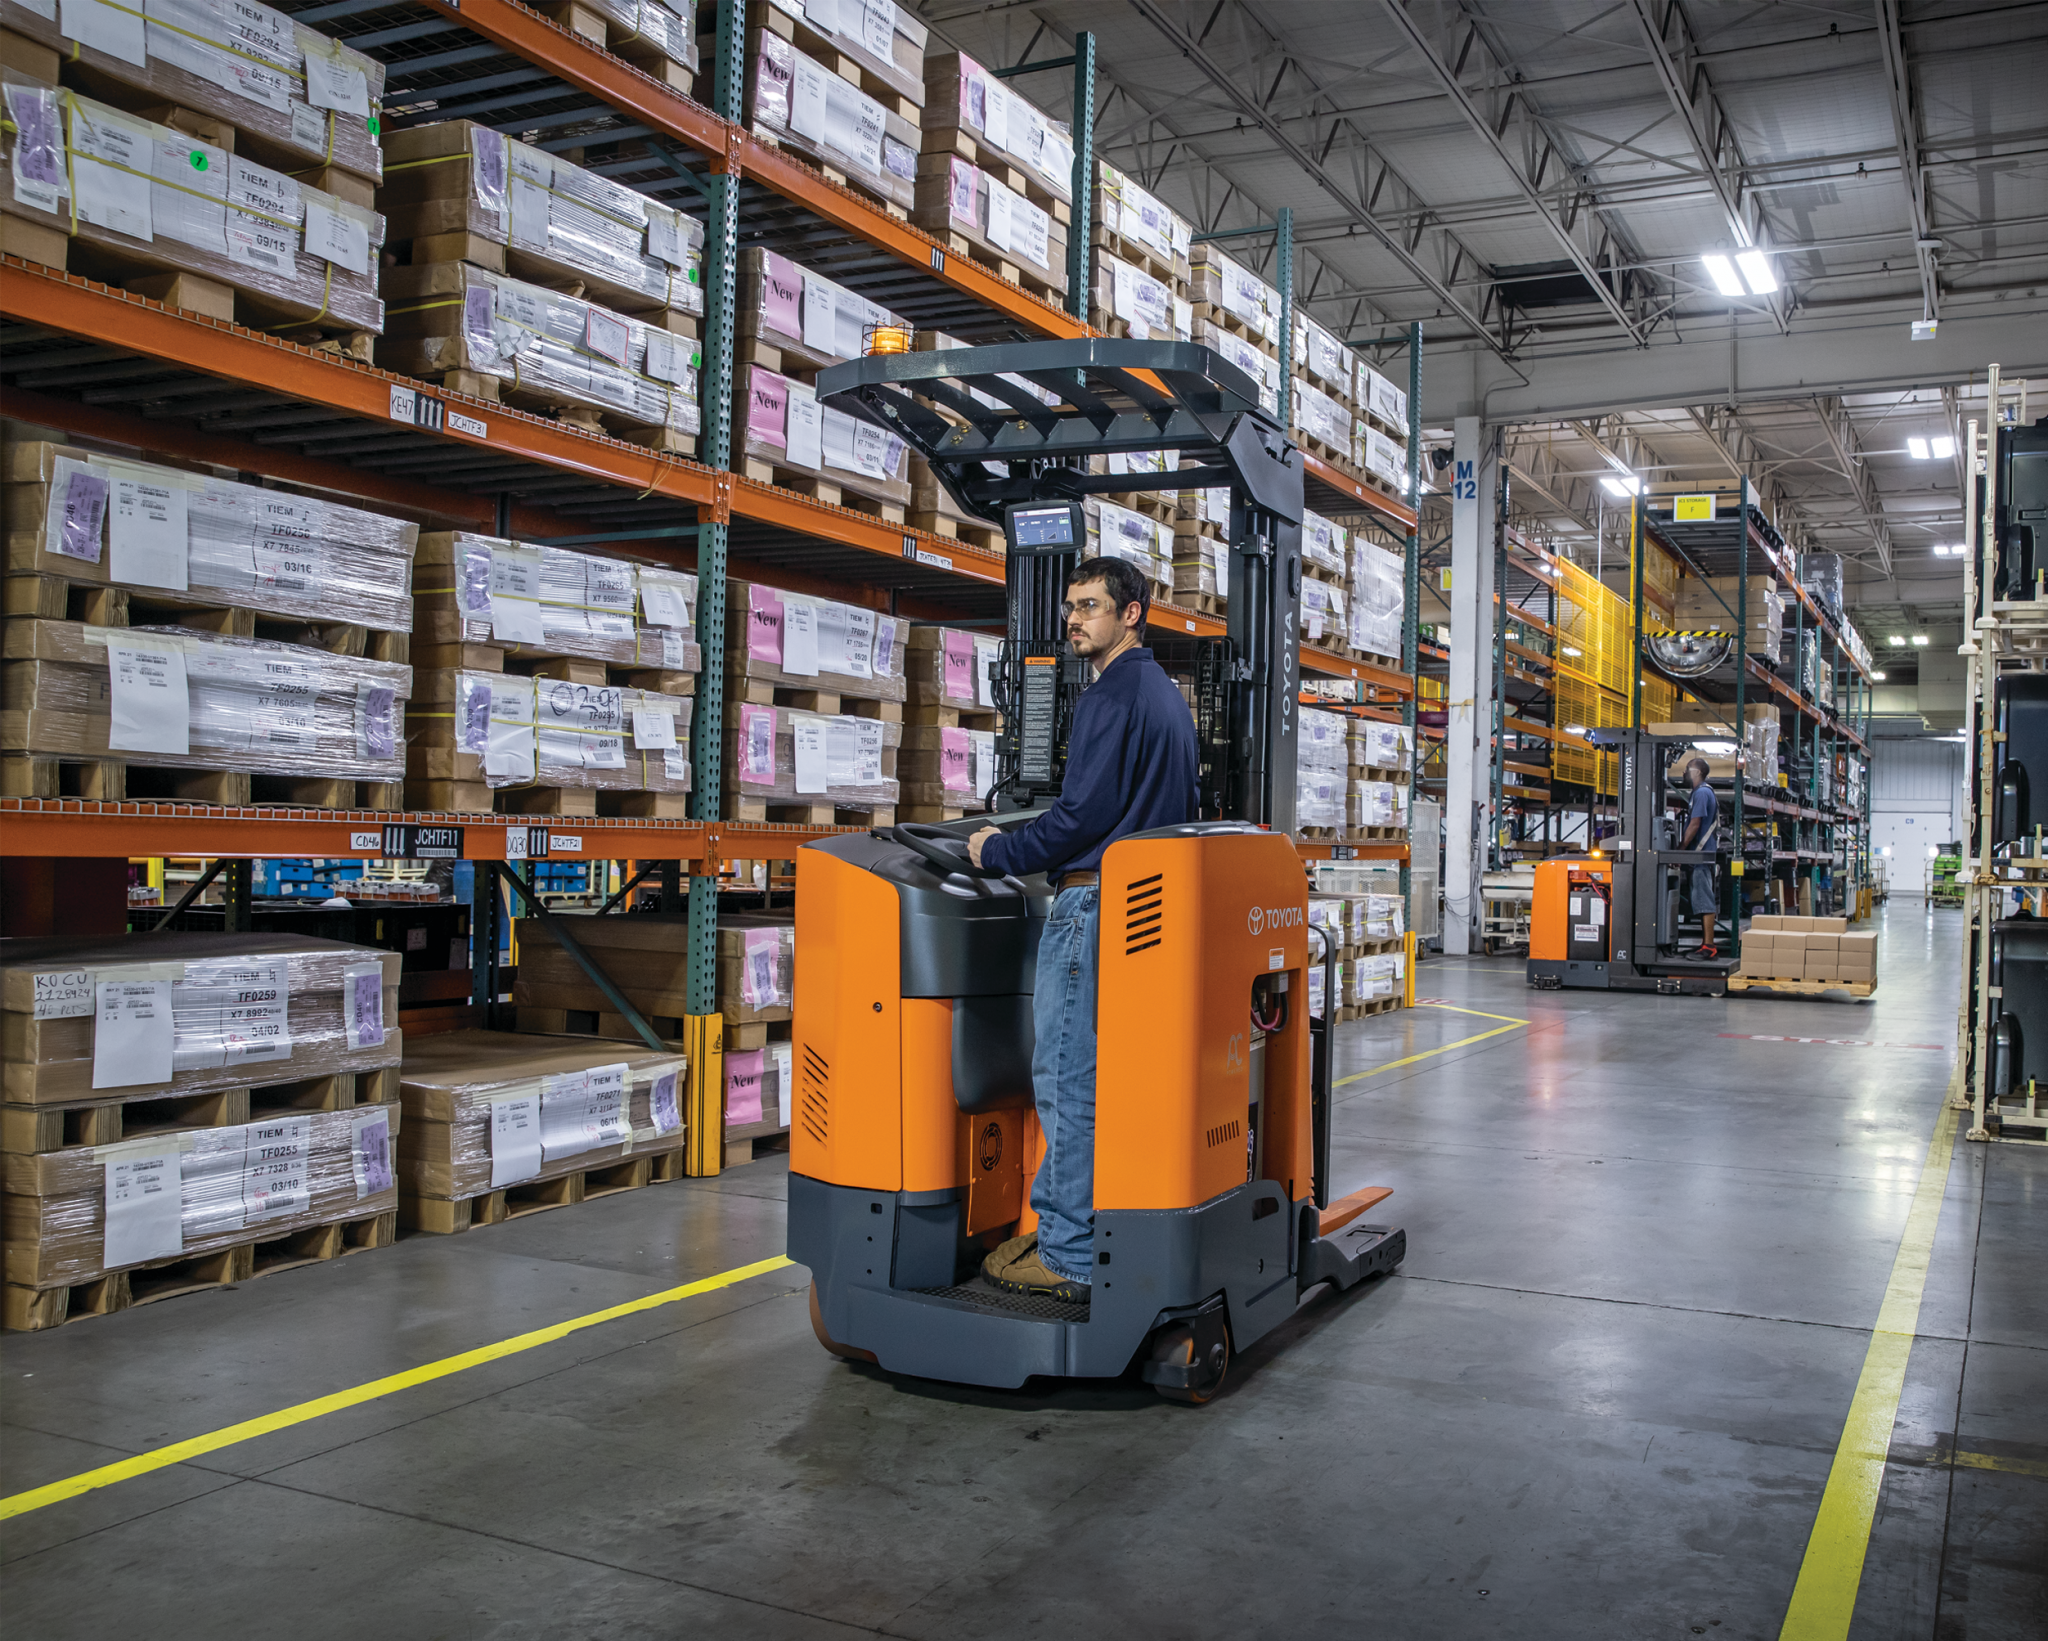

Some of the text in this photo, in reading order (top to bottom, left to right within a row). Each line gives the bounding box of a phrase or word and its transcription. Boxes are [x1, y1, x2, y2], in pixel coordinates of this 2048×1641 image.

[235, 3, 263, 23] TIEM
[230, 40, 243, 52] X7
[764, 57, 791, 81] New
[252, 69, 281, 89] 09/15
[861, 116, 879, 133] TF0241
[239, 170, 269, 189] TIEM
[244, 191, 285, 214] TF0294
[256, 234, 287, 253] 09/15
[771, 278, 796, 304] New
[391, 392, 414, 416] KE47
[755, 390, 780, 411] New
[862, 427, 880, 440] TF0254
[1456, 460, 1473, 480] M
[1454, 480, 1477, 500] 12
[266, 504, 294, 517] TIEM
[263, 541, 275, 550] X7
[279, 543, 300, 554] 7845
[754, 611, 780, 628] New
[849, 613, 863, 623] TIEM
[850, 627, 868, 637] TF0267
[854, 652, 868, 662] 05/20
[948, 653, 967, 668] New
[265, 663, 292, 675] TIEM
[1281, 611, 1293, 736] TOYOTA
[270, 683, 309, 695] TF0255
[258, 697, 270, 706] X7
[599, 738, 619, 748] 09/18
[946, 749, 964, 763] New
[355, 835, 380, 848] CD46
[415, 829, 458, 846] JCHTF11
[1266, 906, 1304, 929] TOYOTA
[239, 990, 277, 1002] TF0259
[231, 1010, 243, 1019] X7
[246, 1008, 268, 1018] 8992
[251, 1024, 280, 1037] 04/02
[594, 1076, 611, 1086] TIEM
[731, 1074, 758, 1089] New
[596, 1090, 621, 1102] TF0271
[589, 1106, 597, 1115] X7
[600, 1116, 618, 1127] 06/11
[257, 1128, 284, 1139] TIEM
[261, 1144, 298, 1159] TF0255
[253, 1166, 265, 1177] X7
[268, 1162, 289, 1174] 7328
[271, 1179, 299, 1192] 03/10
